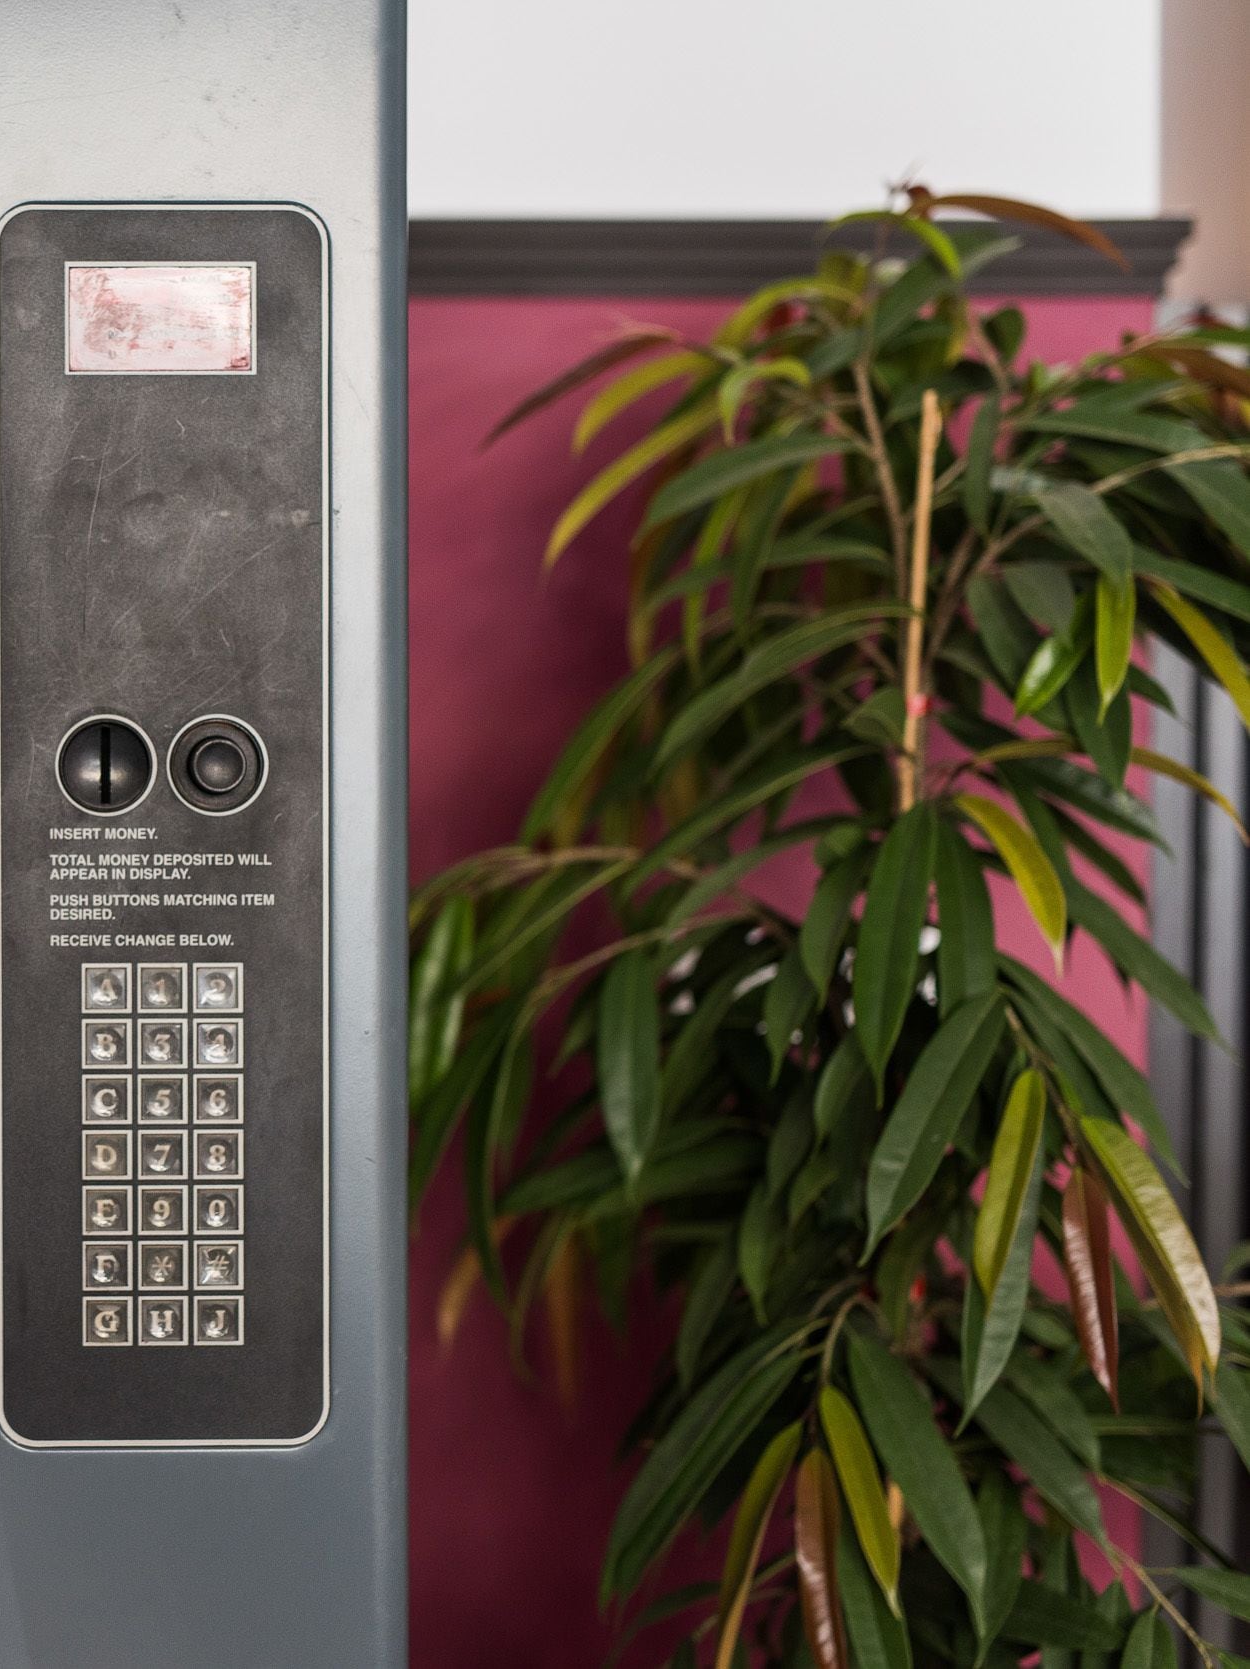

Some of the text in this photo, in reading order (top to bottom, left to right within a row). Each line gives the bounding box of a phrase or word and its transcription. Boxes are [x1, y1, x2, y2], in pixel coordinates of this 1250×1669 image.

[50, 827, 158, 840] INSERT MONEY.
[50, 853, 272, 866] TOTAL MONEY DEPOSITED WILL
[49, 867, 191, 880] APPEAR IN DISPLAY.
[50, 893, 275, 907] PUSH BUTTONS MATCHING ITEM
[50, 908, 116, 921] DESIRED.
[50, 934, 234, 947] RECEIVE CHANGE BELOW.
[94, 1088, 118, 1112] C
[208, 1088, 227, 1111] 6
[94, 1144, 118, 1167] D
[152, 1199, 171, 1221] 9
[93, 1310, 119, 1333] G
[149, 1310, 174, 1333] H
